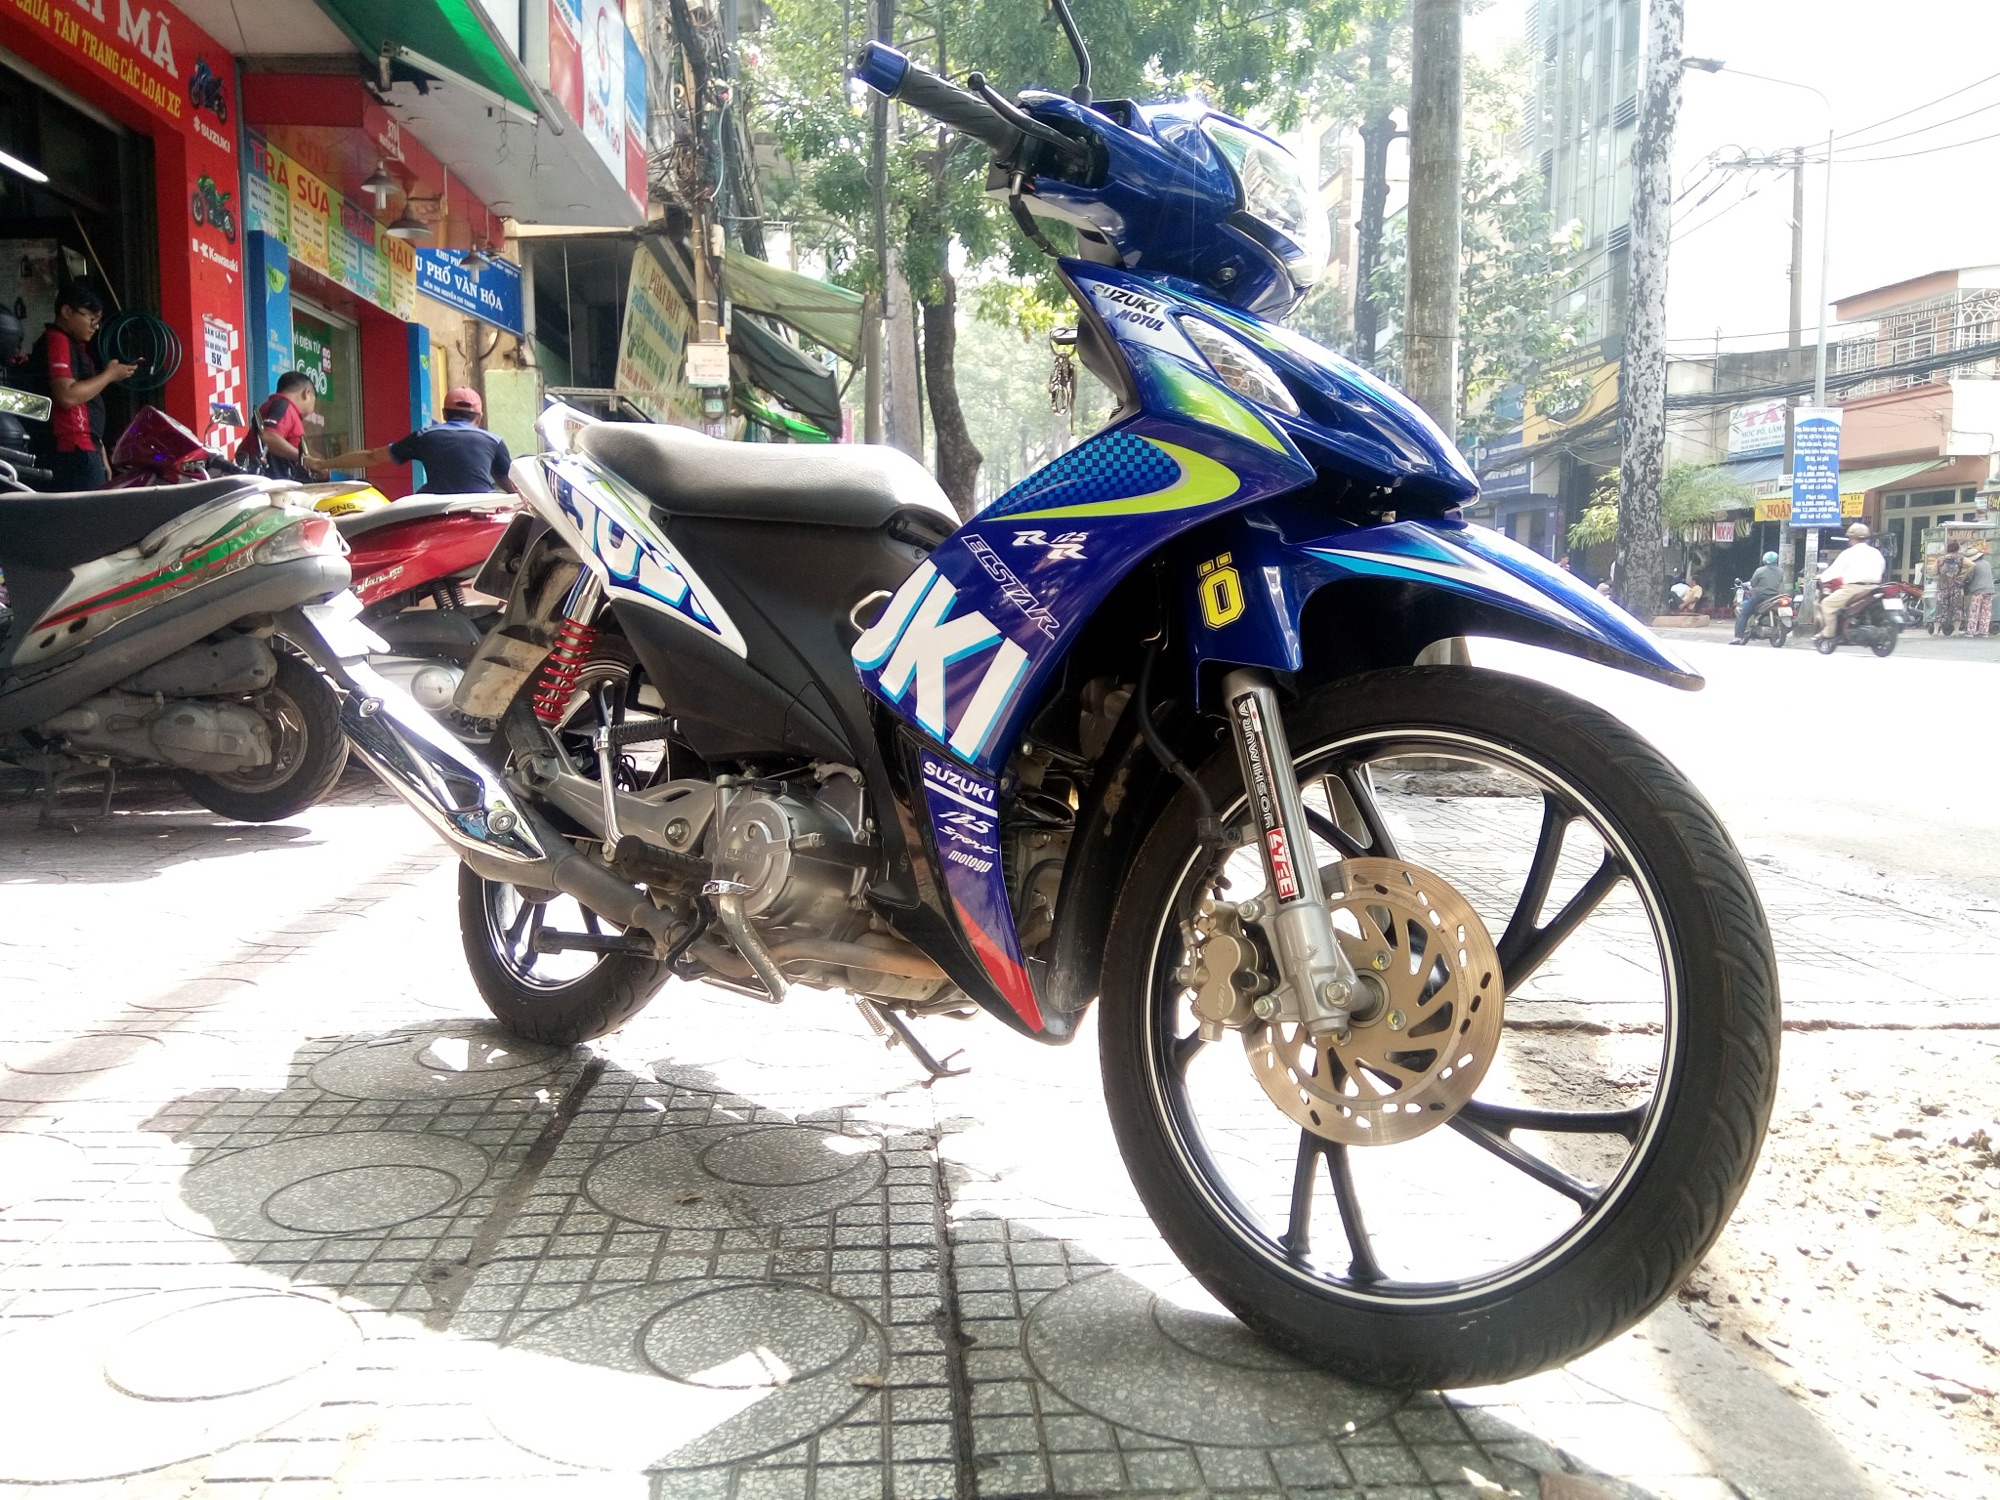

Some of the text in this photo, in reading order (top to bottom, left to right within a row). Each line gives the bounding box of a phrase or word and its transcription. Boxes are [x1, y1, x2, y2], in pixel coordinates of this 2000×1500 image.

[82, 28, 119, 73] TRANG
[120, 58, 141, 89] CÁC
[142, 73, 167, 109] LOẠI
[166, 86, 182, 118] XE
[200, 123, 231, 154] SUZUKI
[251, 140, 290, 190] TRÀ
[297, 174, 331, 218] SỮA
[380, 234, 414, 273] CHÂU
[207, 247, 239, 273] Kawasaki
[435, 248, 450, 263] KHU
[426, 260, 452, 286] PHỐ
[454, 273, 479, 299] VĂN
[1089, 284, 1160, 315] SUZUKI
[1115, 309, 1166, 332] MOTUL
[211, 351, 222, 367] 5K
[960, 534, 1060, 641] ECSTAR
[923, 761, 995, 803] SUZUKI
[948, 850, 994, 873] motogp
[1268, 833, 1295, 897] ヨシムラ
